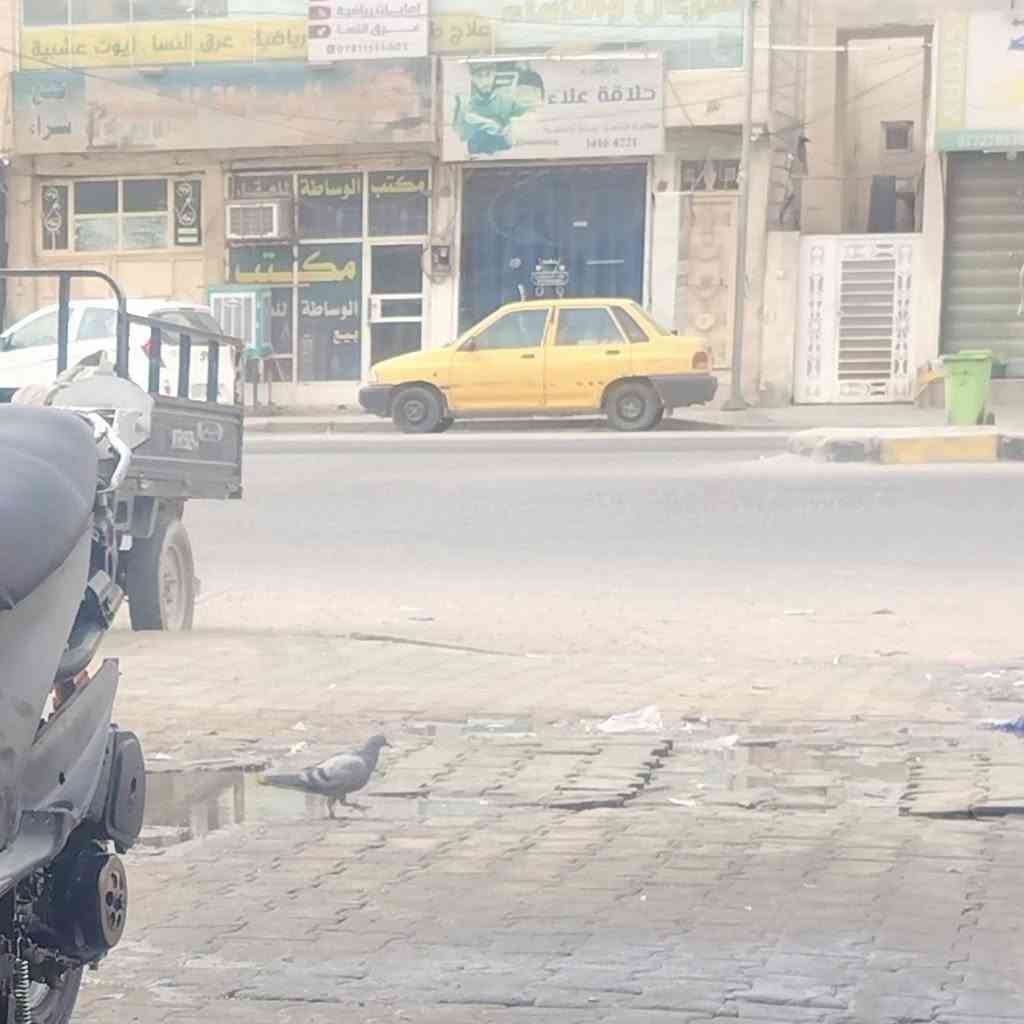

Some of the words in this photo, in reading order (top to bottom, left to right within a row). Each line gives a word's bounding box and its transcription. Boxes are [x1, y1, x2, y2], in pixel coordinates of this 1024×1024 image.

[151, 31, 193, 51] النسا
[199, 33, 233, 54] عرق
[597, 84, 657, 104] حلاقة
[301, 175, 361, 200] الوساطة
[370, 175, 428, 199] مكتب
[302, 299, 358, 320] الوساطة
